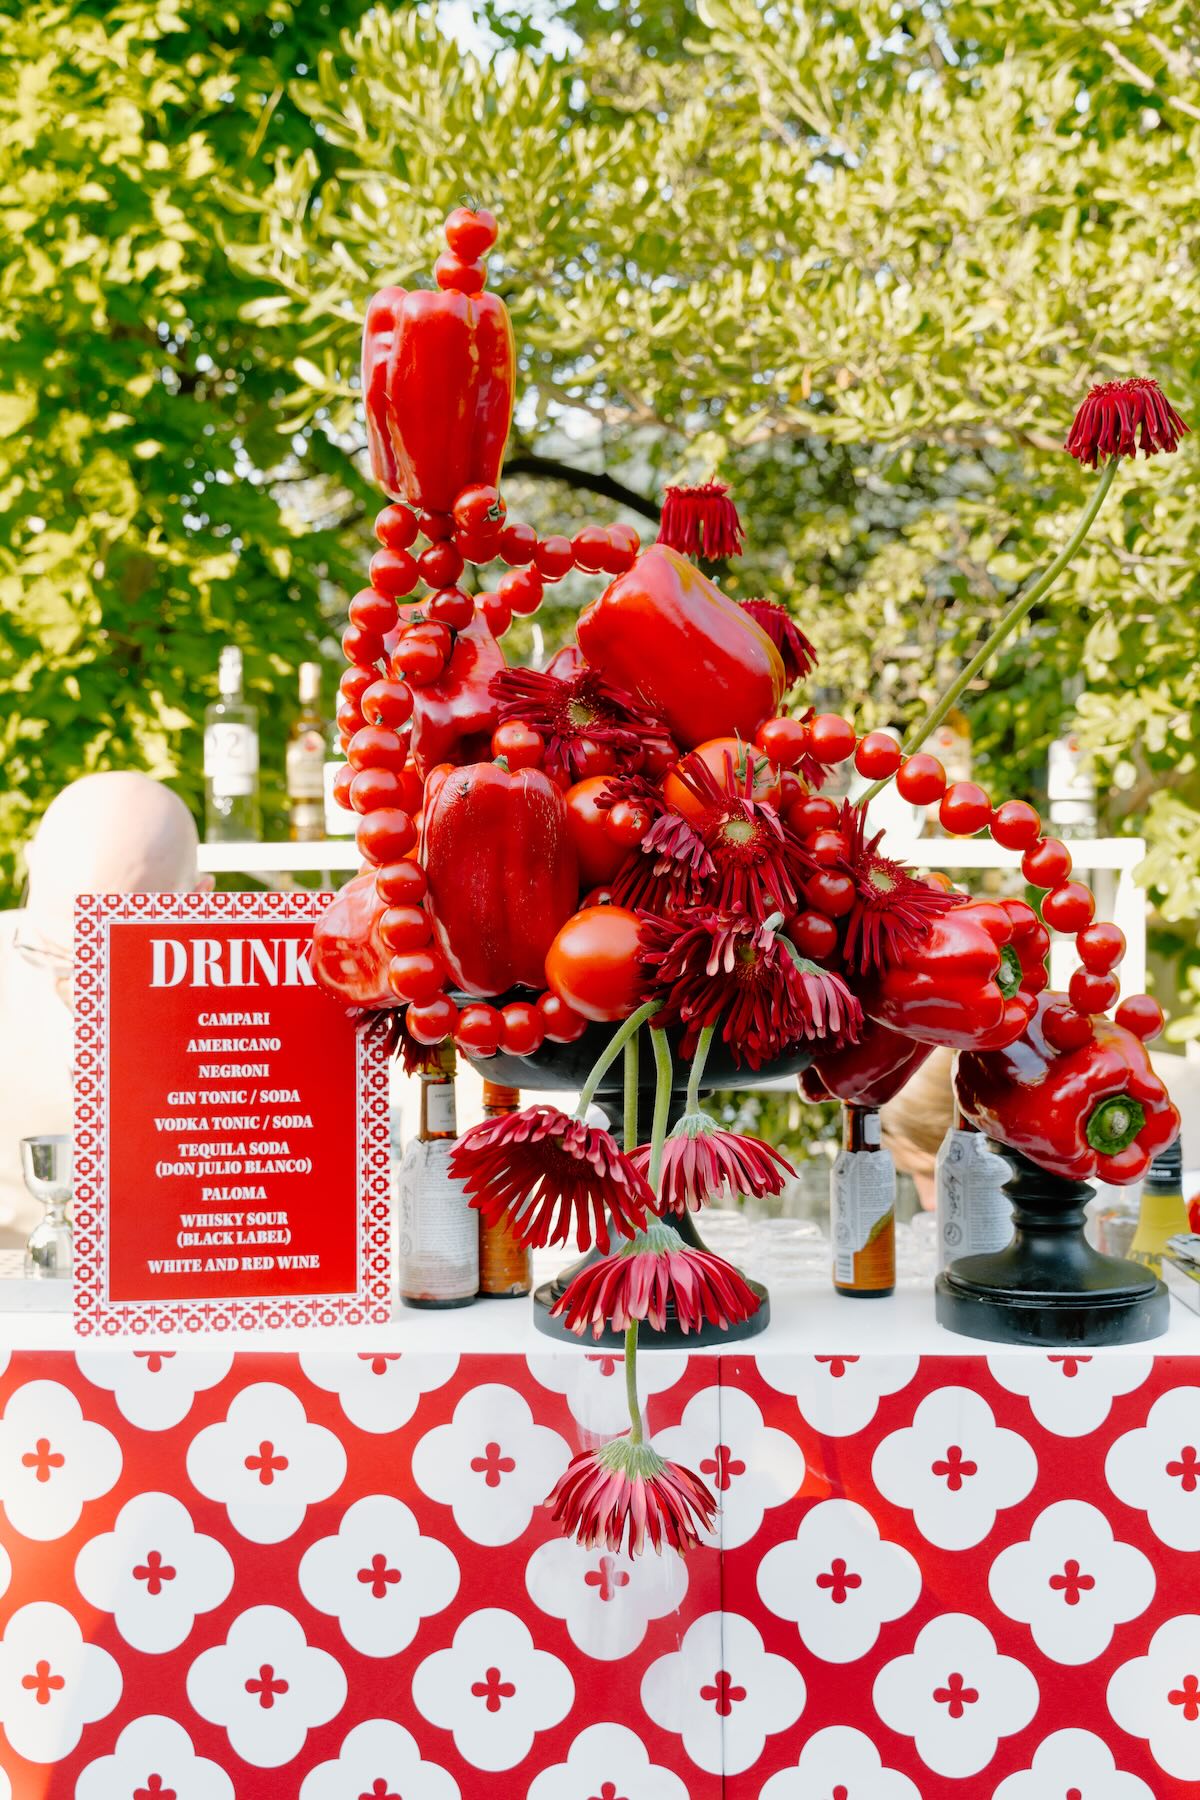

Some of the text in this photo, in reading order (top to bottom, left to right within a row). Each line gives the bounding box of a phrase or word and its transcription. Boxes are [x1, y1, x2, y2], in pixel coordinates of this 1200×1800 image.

[198, 1013, 269, 1026] CAMPARI
[187, 1038, 281, 1052] AMERICANO
[199, 1064, 269, 1078] NEGRONI
[167, 1090, 300, 1105] GIN TONIC / SODA
[154, 1115, 313, 1131] VODKA TONIC / SODA
[178, 1142, 290, 1159] TEQUILA SODA
[156, 1158, 312, 1178] (DON JULIO BLANCO)
[202, 1187, 267, 1200] PALOMA
[180, 1212, 288, 1227] WHISKY SOUR
[177, 1228, 291, 1248] (BLACK LABEL)
[148, 1255, 320, 1273] WHITE AND RED WINE
